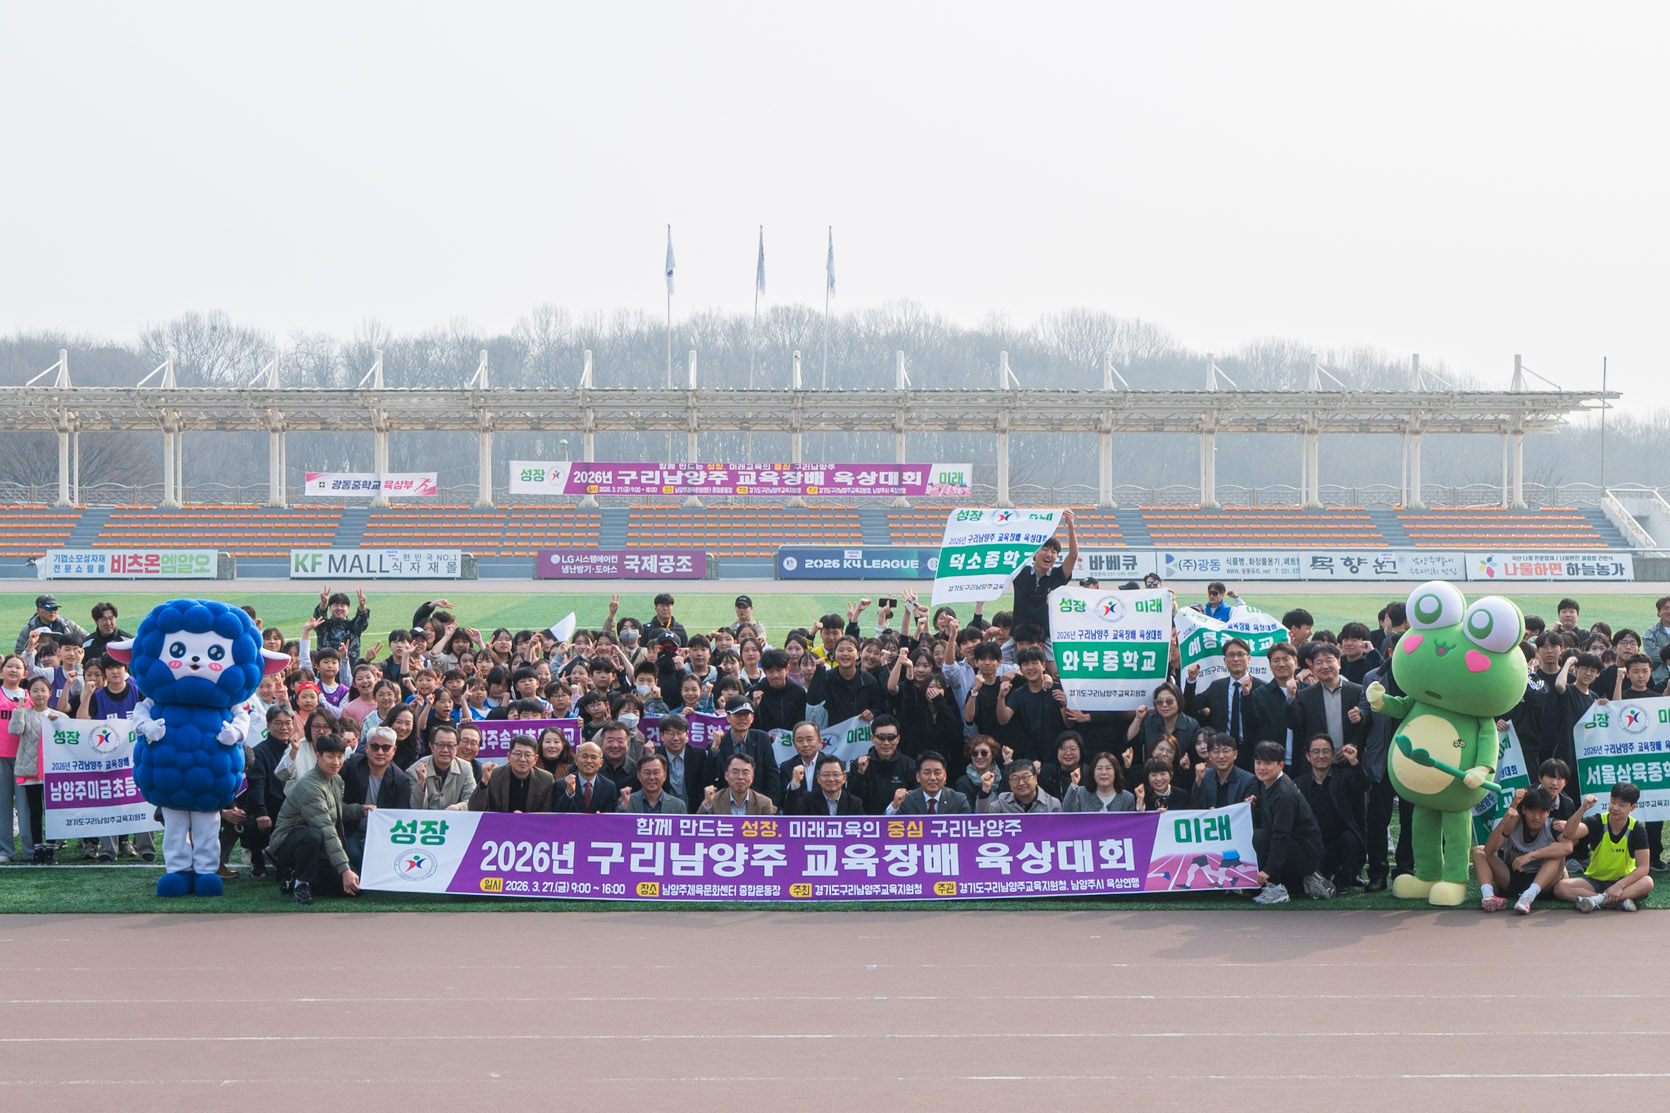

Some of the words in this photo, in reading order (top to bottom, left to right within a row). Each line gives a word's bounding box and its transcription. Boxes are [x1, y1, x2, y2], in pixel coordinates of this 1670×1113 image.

[520, 468, 546, 482] 성장
[573, 470, 613, 485] 2026년
[617, 470, 729, 486] 구리남양주
[736, 470, 825, 486] 교육장배
[833, 470, 922, 486] 육상대회
[939, 471, 964, 486] 미래
[957, 509, 984, 522] 성장
[967, 533, 996, 544] 구리남양주
[295, 553, 322, 573] KF
[328, 553, 391, 573] MALL
[624, 554, 693, 573] 국제공조
[804, 560, 840, 569] 2026
[863, 560, 919, 569] LEAGUE
[1089, 554, 1138, 571] 바베큐
[1504, 562, 1562, 576] 나물하면
[1566, 562, 1625, 576] 하늘농가
[1059, 598, 1086, 613] 성장
[1135, 598, 1162, 613] 미래
[1056, 630, 1076, 641] 2026년
[1078, 629, 1109, 641] 구리남양주
[1112, 629, 1137, 641] 교육장배
[1139, 629, 1163, 641] 육상대회
[1062, 649, 1157, 672] 와부중학교
[53, 730, 80, 745] 성장
[846, 726, 870, 744] 미래
[1583, 745, 1603, 757] 2026년
[1604, 742, 1634, 755] 구리남양주
[1638, 740, 1662, 753] 교육장배
[52, 761, 70, 772] 2026년
[72, 760, 103, 771] 구리남양주
[106, 757, 130, 770] 교육장배
[50, 776, 142, 802] 남양주미금초등
[390, 819, 450, 846] 성장
[637, 817, 673, 837] 함께
[680, 819, 734, 837] 만드는
[789, 820, 880, 838] 미래교육의
[887, 820, 924, 838] 중심
[930, 819, 1022, 839] 구리남양주
[1173, 814, 1233, 844] 미래
[480, 841, 575, 876] 2026년
[587, 841, 788, 878] 구리남양주
[801, 843, 960, 877] 교육장배
[975, 838, 1136, 877] 육상대회
[484, 880, 502, 892] 일시
[505, 880, 531, 893] 2026.
[532, 881, 540, 893] 3.
[571, 881, 592, 894] 9:00
[602, 883, 626, 895] 16:00
[641, 883, 658, 896] 장소
[662, 883, 737, 897] 남양주체육문화센터
[739, 884, 781, 897] 종합운동장
[793, 884, 810, 897] 주최
[815, 883, 923, 897] 경기도구리남양주교육지원청
[938, 882, 955, 894] 주관
[1071, 878, 1104, 891] 남양주시
[1106, 876, 1140, 889] 육상연맹
